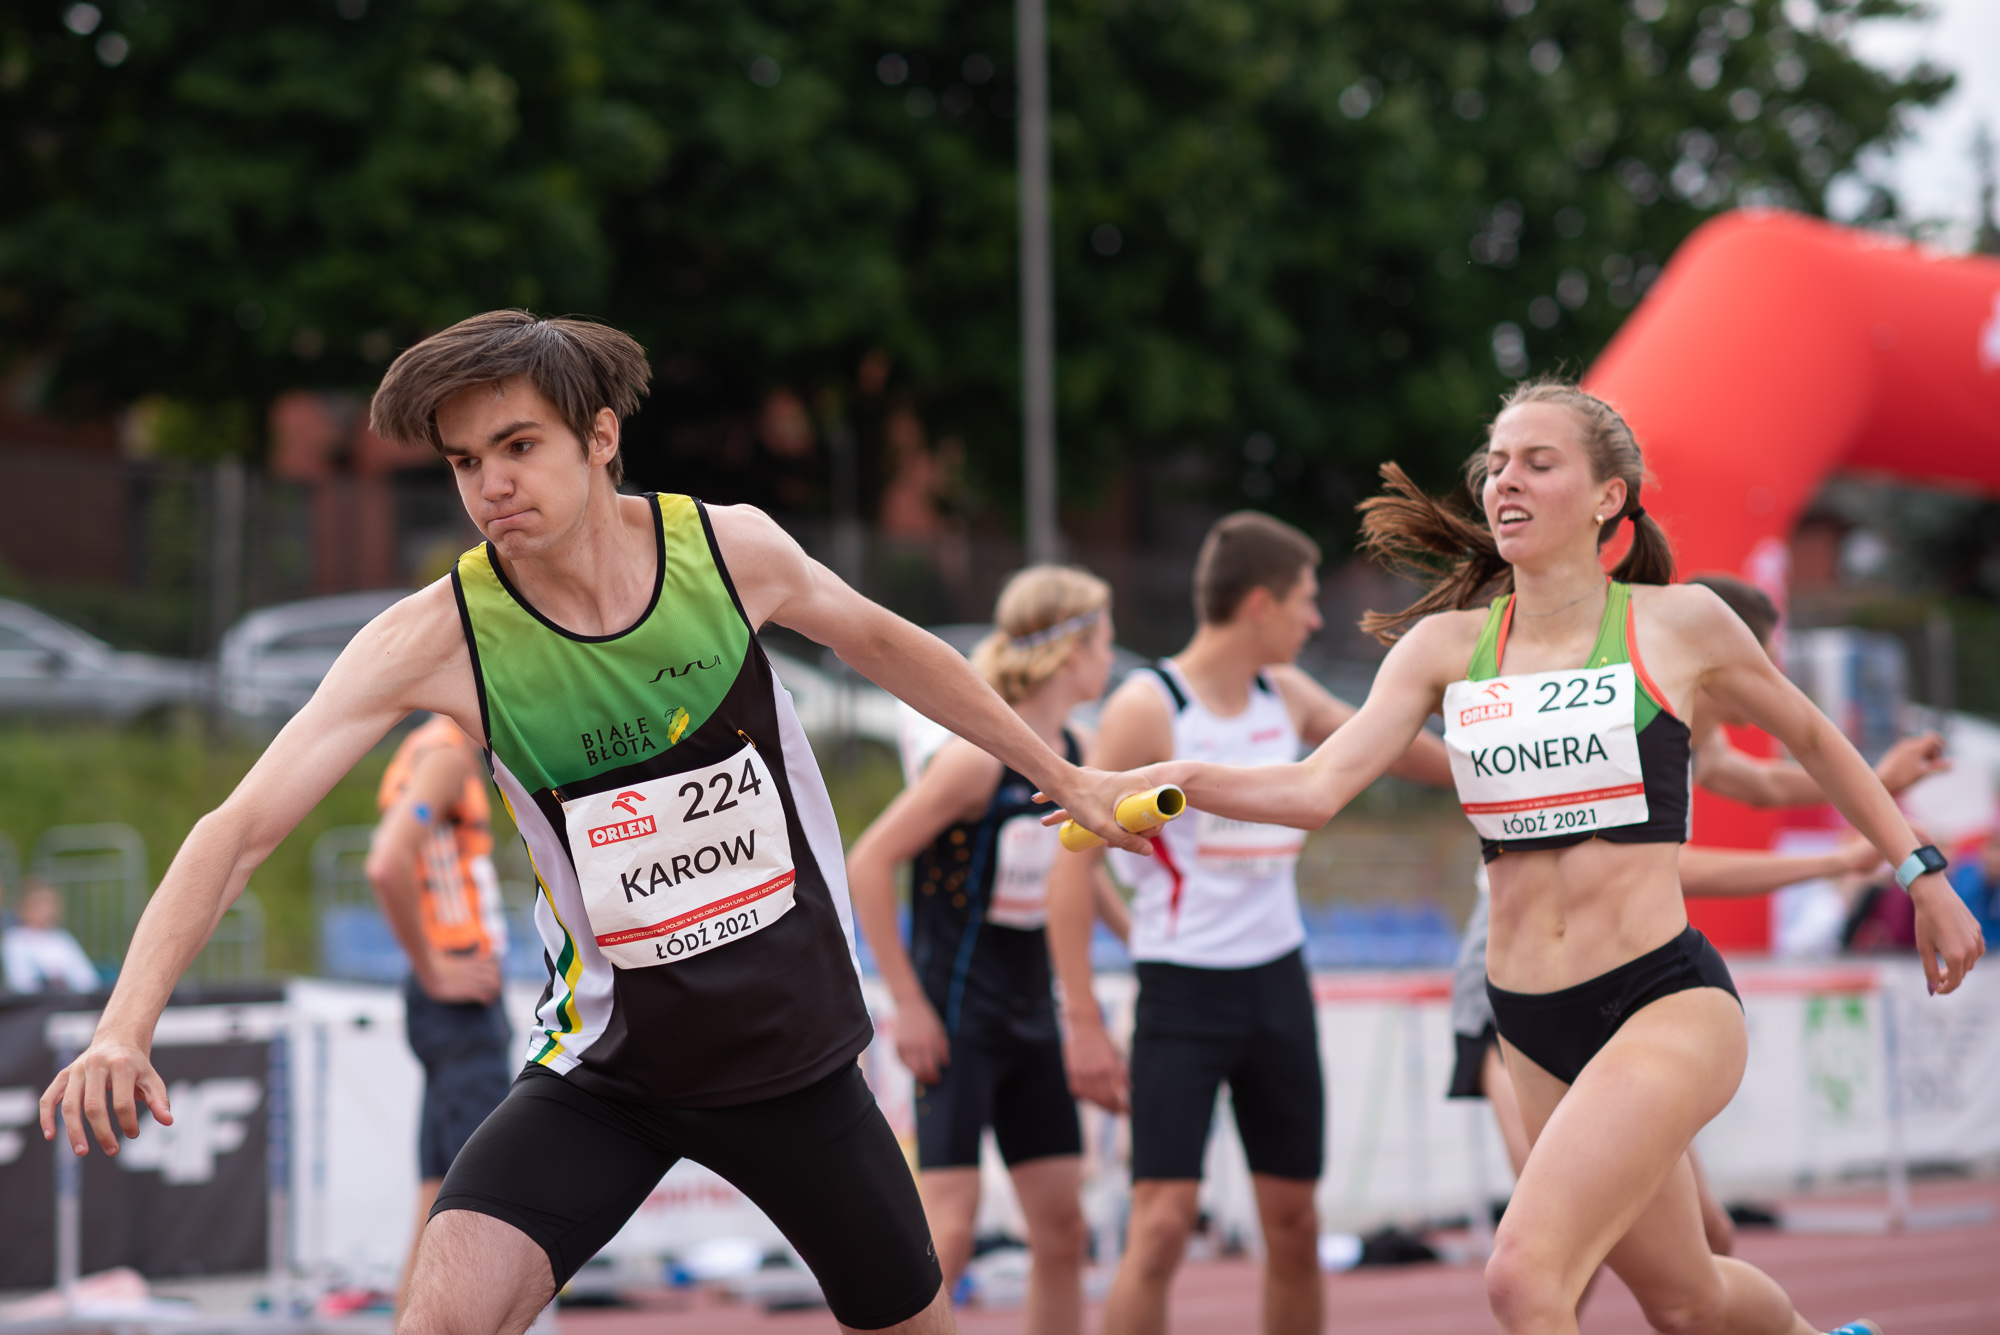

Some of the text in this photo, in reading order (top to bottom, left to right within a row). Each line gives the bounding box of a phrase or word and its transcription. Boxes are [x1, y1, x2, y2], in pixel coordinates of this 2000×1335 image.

[1537, 673, 1616, 713] 225
[581, 717, 650, 750] BIAŁE
[1461, 704, 1511, 725] ORLEN
[586, 735, 657, 766] BŁOTA
[1471, 733, 1609, 778] KONERA
[678, 757, 762, 823] 224
[591, 817, 654, 846] ORLEN
[1502, 808, 1597, 834] ŁÓDŹ 2021
[620, 829, 756, 903] KAROW
[622, 927, 666, 940] MISTRZOSTWA
[665, 919, 686, 930] POLSKI
[692, 901, 733, 919] WIELOBOJACH
[761, 876, 791, 894] SZTAFETACH
[655, 908, 760, 960] ŁÓDŹ 2021
